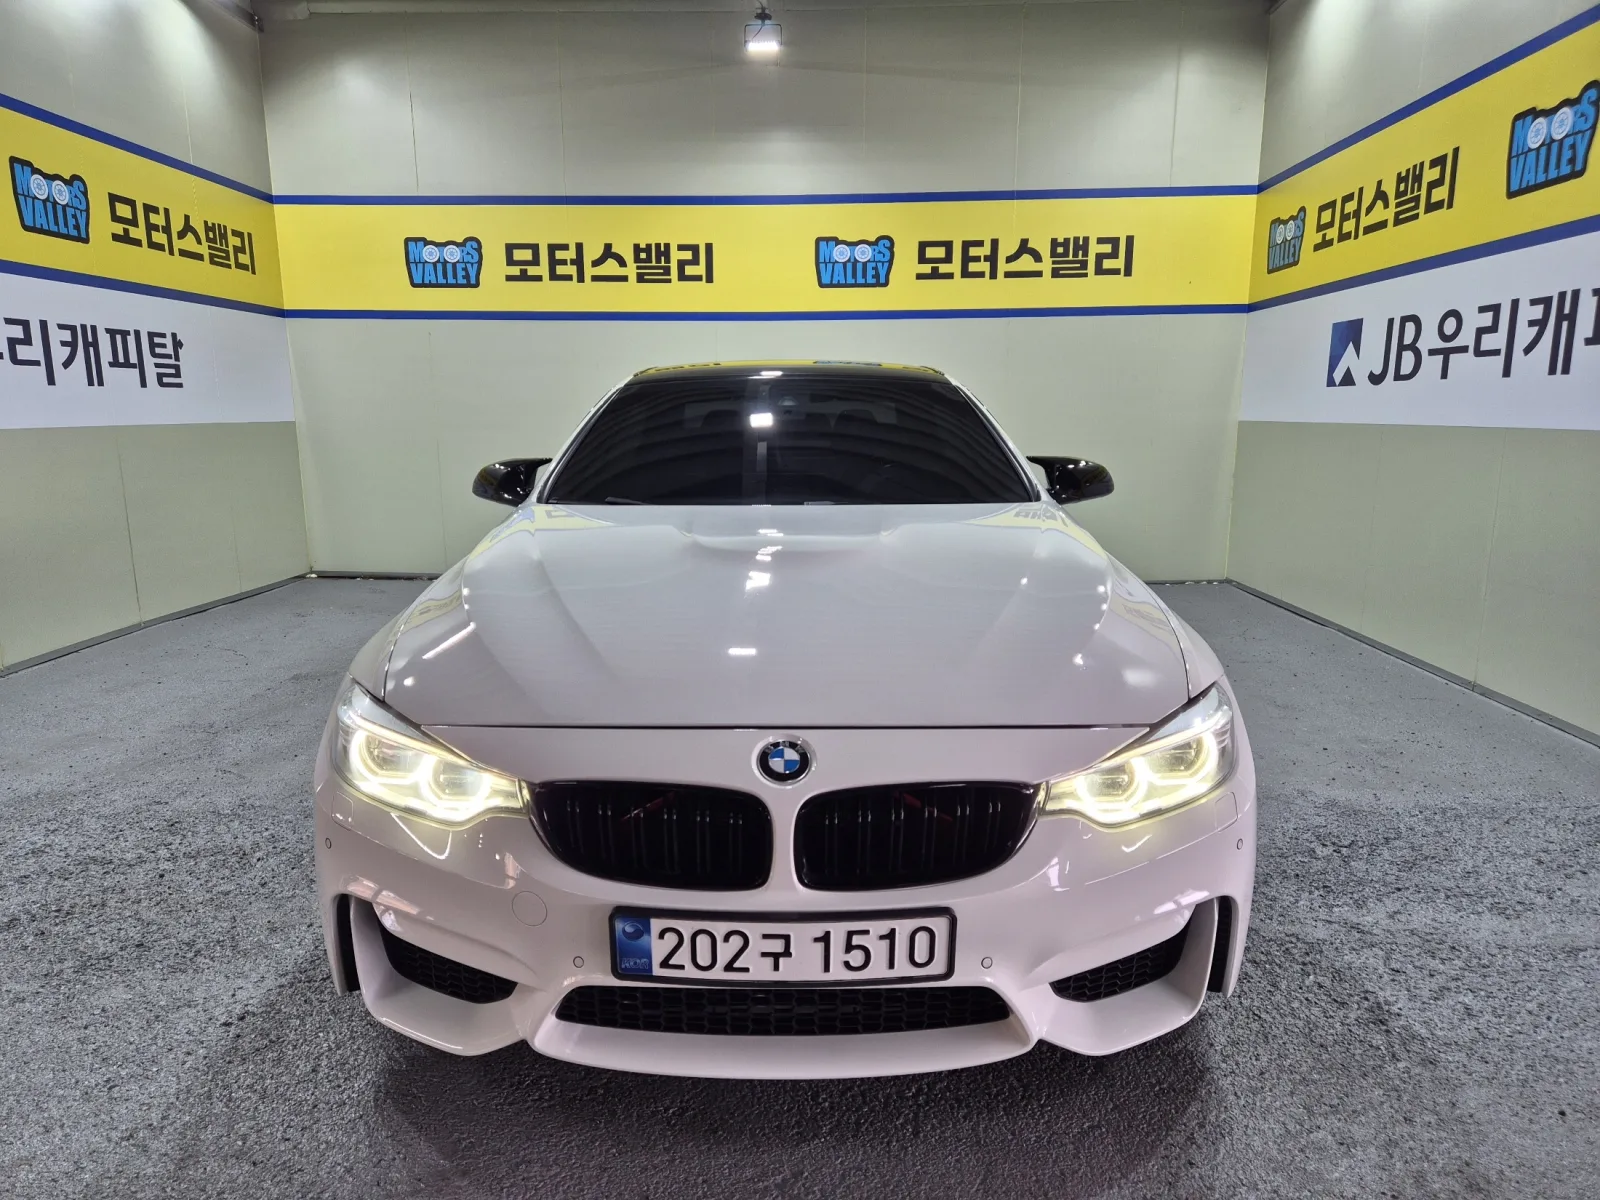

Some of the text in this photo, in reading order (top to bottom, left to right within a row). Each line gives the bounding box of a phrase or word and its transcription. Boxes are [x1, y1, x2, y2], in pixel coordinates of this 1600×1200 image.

[1509, 128, 1592, 192] VALLEY
[18, 195, 87, 239] VALLEY
[1312, 145, 1460, 253] 모터스밸리
[107, 192, 257, 275] 모터스밸리
[1268, 236, 1302, 270] VALLEY
[409, 262, 479, 284] VALLEY
[504, 241, 714, 284] 모터스밸리
[819, 262, 888, 285] VALLEY
[915, 234, 1135, 281] 모터스밸리
[0, 316, 184, 389] 리캐피탈
[621, 957, 649, 970] KOR
[657, 925, 937, 974] 202구 1510
